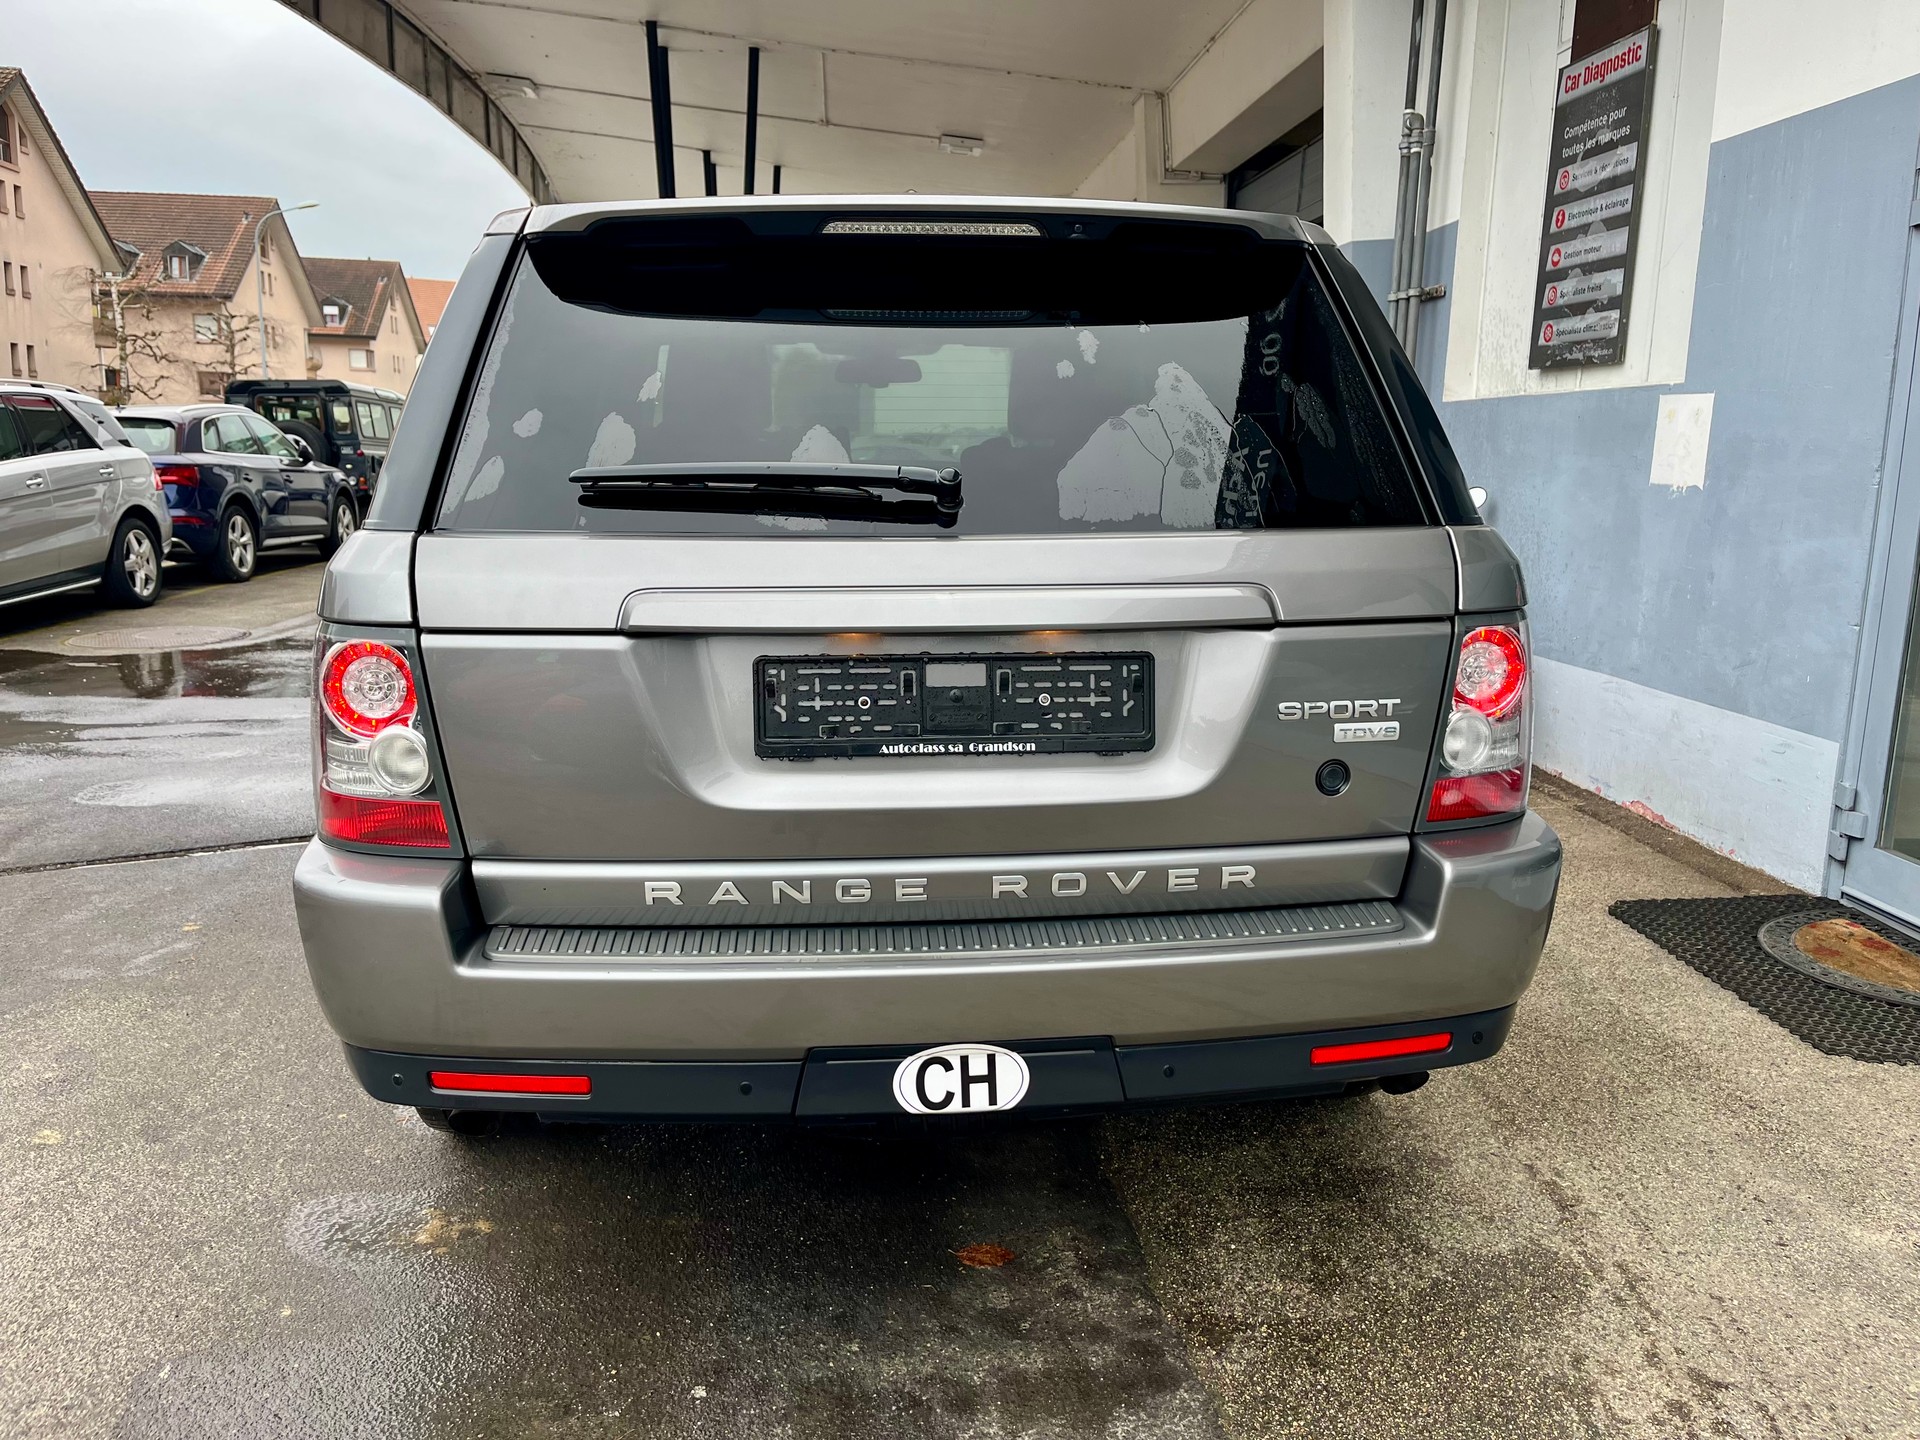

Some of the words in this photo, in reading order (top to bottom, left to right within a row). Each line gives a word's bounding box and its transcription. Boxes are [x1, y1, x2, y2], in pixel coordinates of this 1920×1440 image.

[1564, 71, 1582, 94] Car
[1583, 42, 1643, 84] Diagnostic
[1564, 114, 1607, 140] Compétence
[1609, 106, 1627, 123] pour
[1562, 142, 1584, 159] toutes
[1598, 124, 1631, 146] marques
[1563, 248, 1582, 260] Gestion
[1583, 245, 1602, 255] moteur
[1278, 698, 1401, 720] SPORT
[879, 743, 945, 754] Autoclass
[968, 741, 1036, 753] Grandson
[644, 877, 929, 906] RANGE
[992, 864, 1257, 900] ROVER
[915, 1053, 998, 1111] CH
